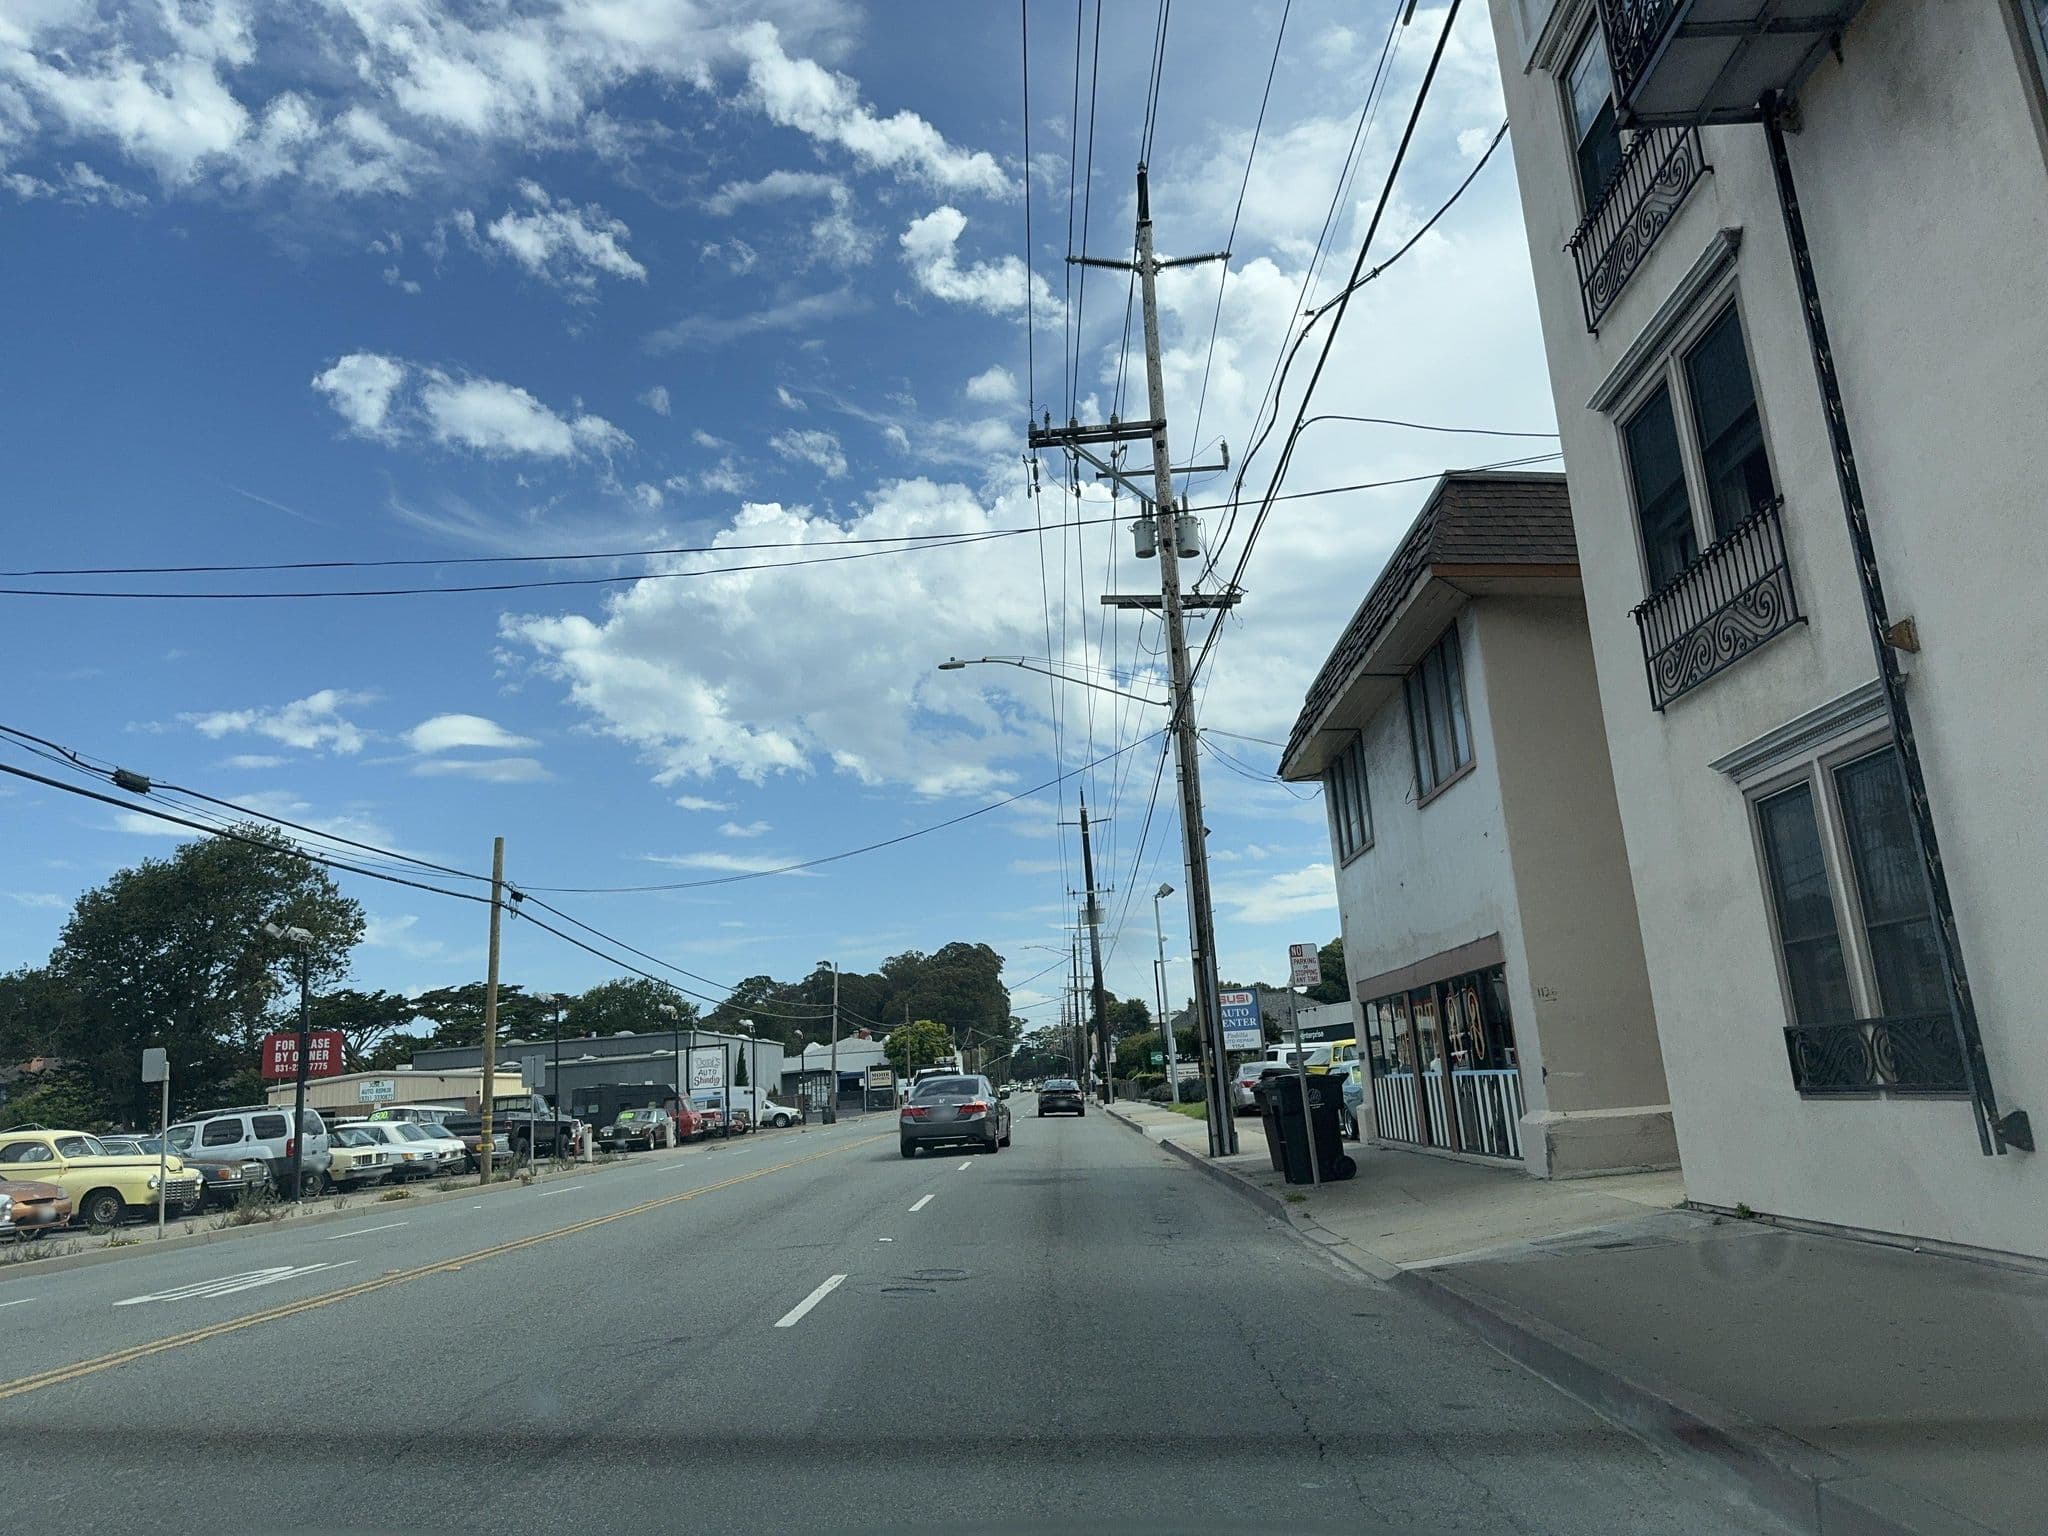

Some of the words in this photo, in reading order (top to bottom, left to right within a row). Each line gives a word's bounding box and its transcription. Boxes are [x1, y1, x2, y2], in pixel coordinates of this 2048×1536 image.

[1291, 945, 1302, 957] NO
[1222, 1008, 1249, 1018] AUTO
[1222, 1017, 1257, 1028] ENTER
[275, 1040, 295, 1051] FOR
[275, 1053, 289, 1063] BY
[292, 1050, 329, 1062] ONER
